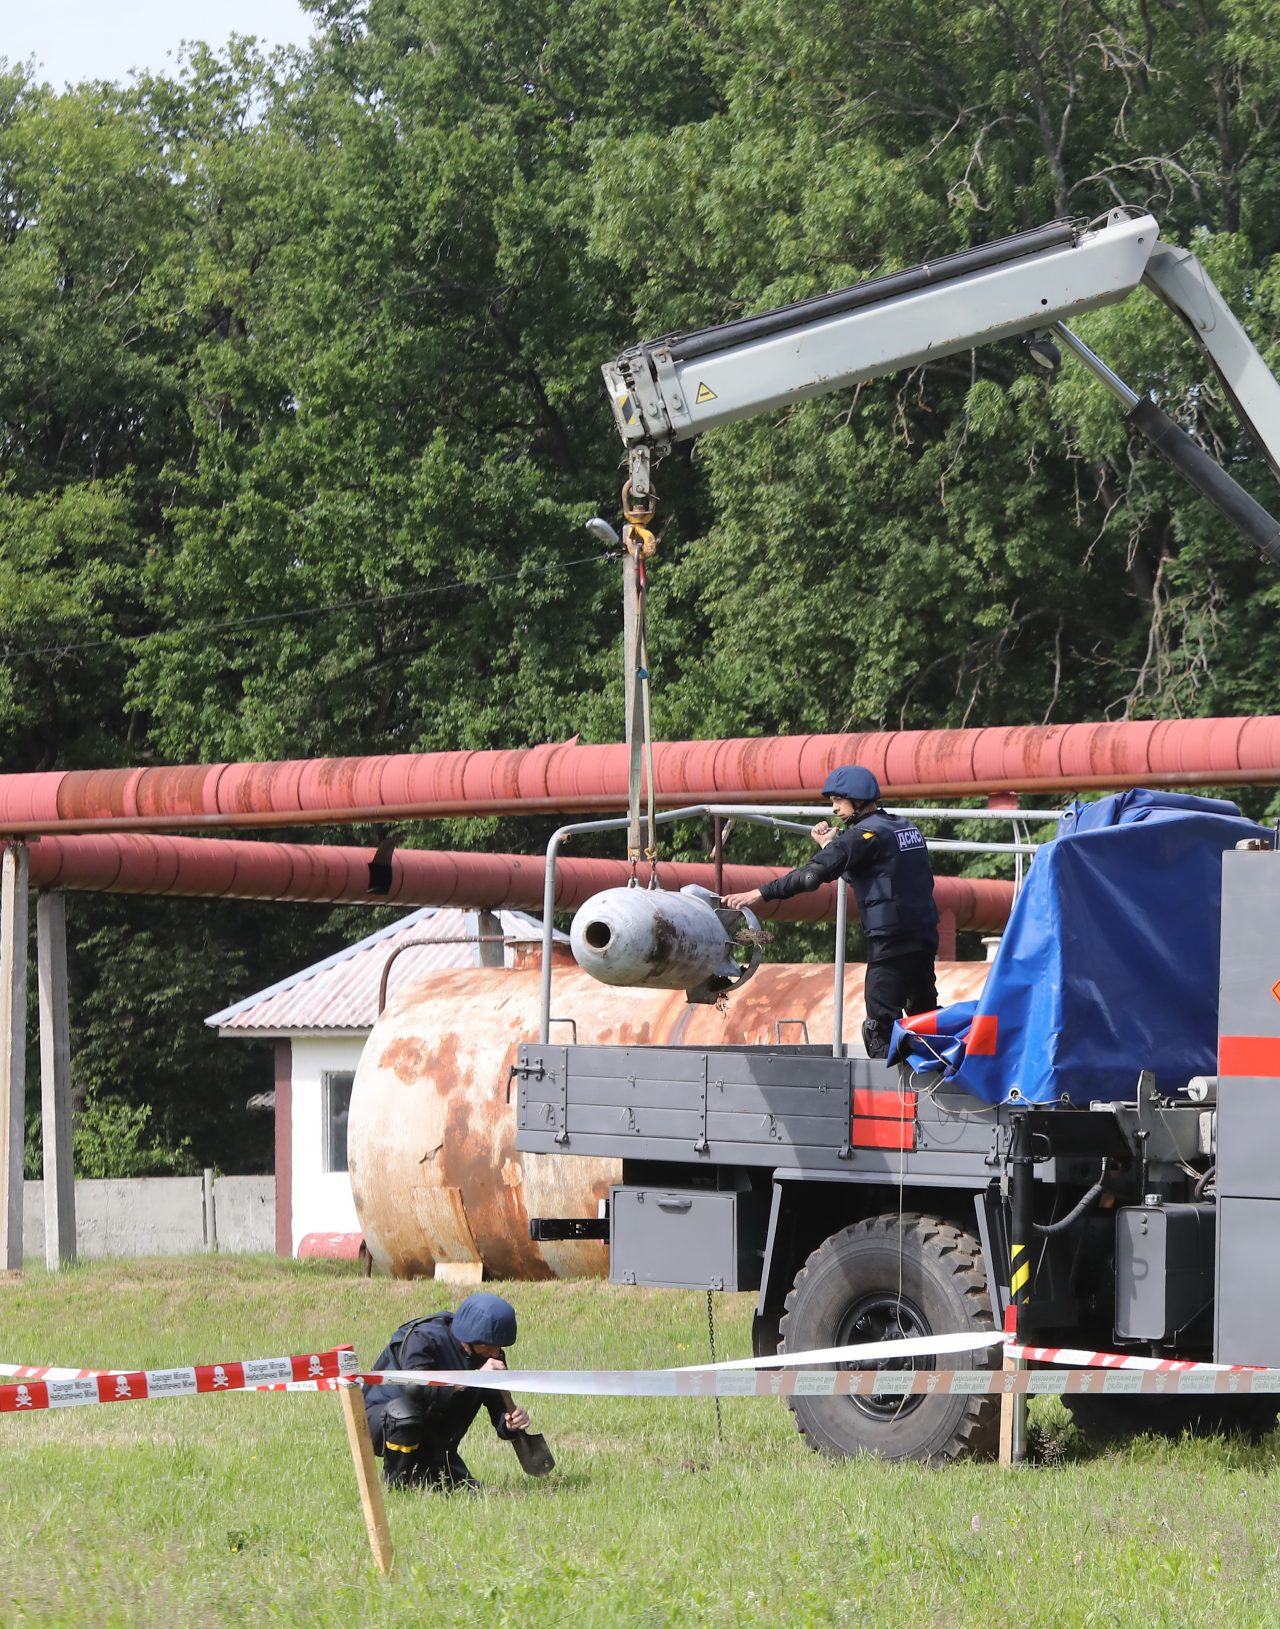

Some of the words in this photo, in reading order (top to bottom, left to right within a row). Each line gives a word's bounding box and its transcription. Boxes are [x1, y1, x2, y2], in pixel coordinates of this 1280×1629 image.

[897, 830, 922, 848] ДСНС
[248, 1364, 268, 1374] Danger
[269, 1361, 286, 1370] Mines
[152, 1373, 172, 1384] Danger
[173, 1371, 190, 1380] Mines
[53, 1383, 74, 1393] Danger
[74, 1381, 92, 1389] Mines
